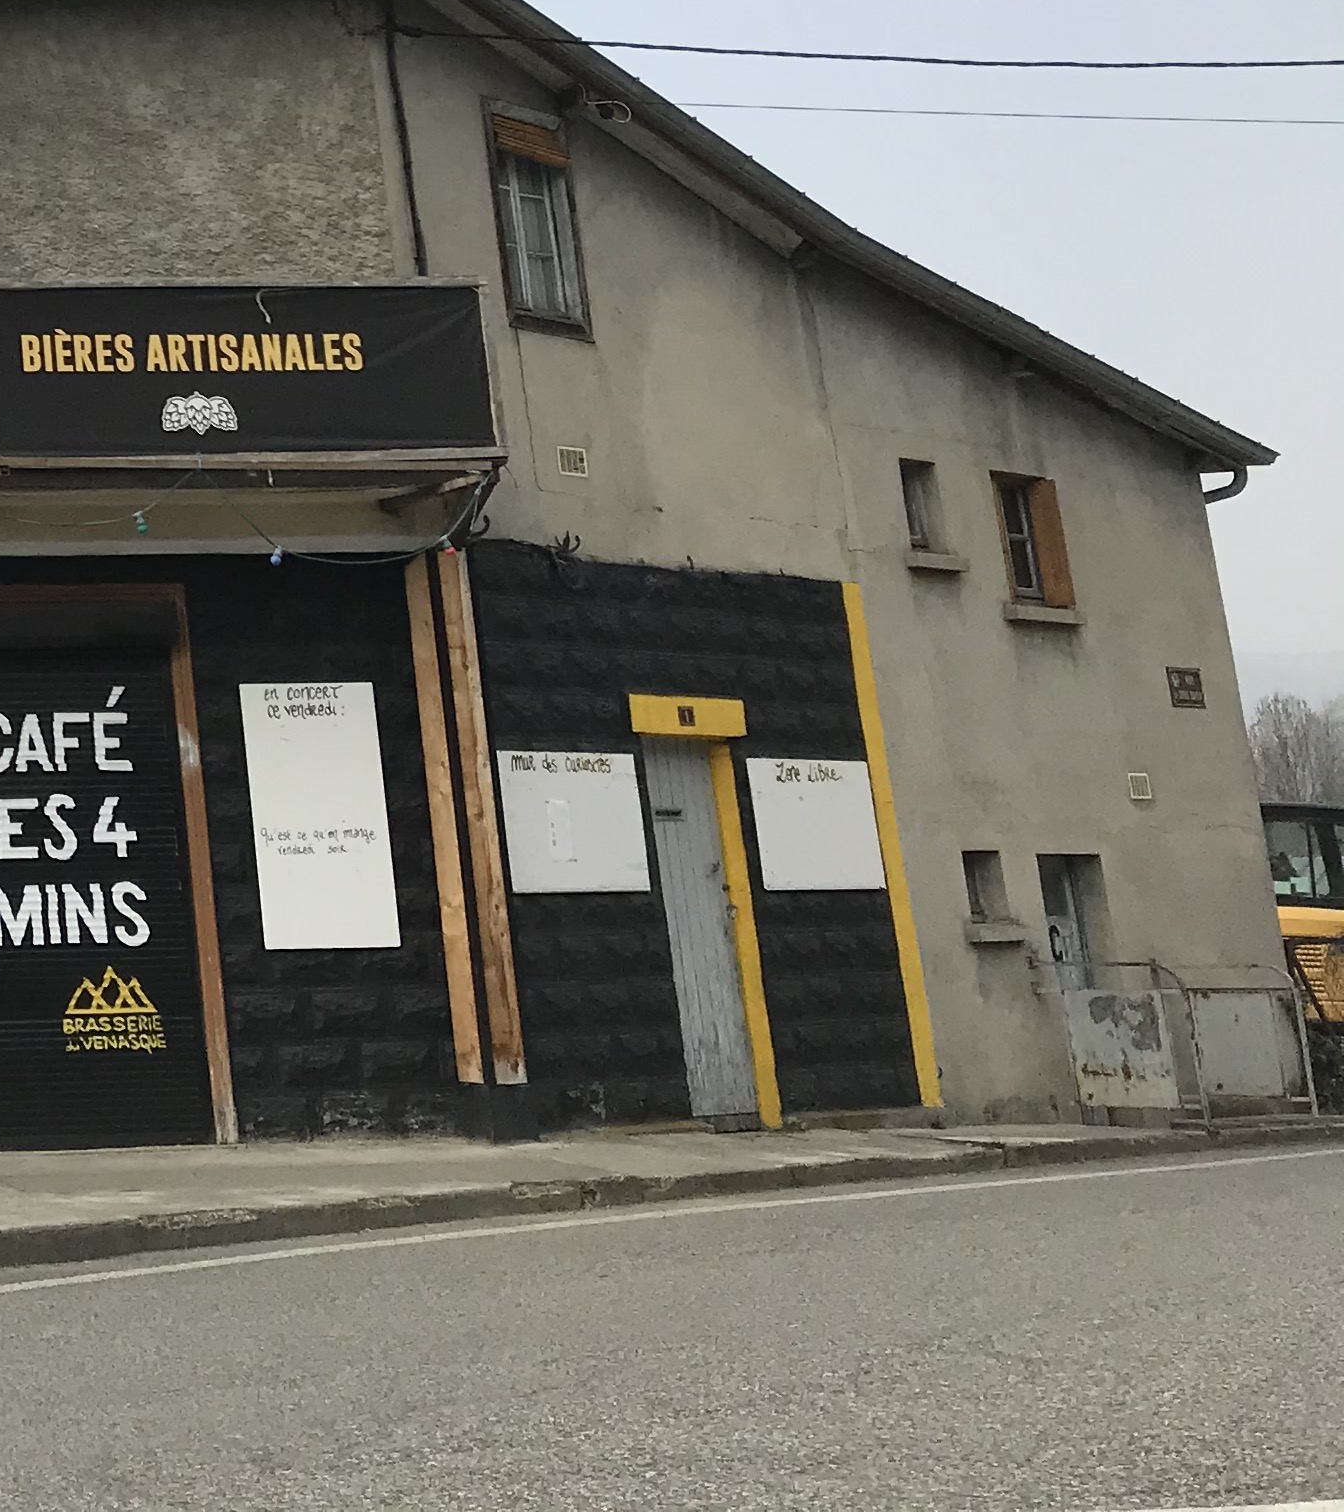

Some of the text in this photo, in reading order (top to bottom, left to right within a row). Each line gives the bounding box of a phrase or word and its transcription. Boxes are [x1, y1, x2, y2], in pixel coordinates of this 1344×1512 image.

[20, 328, 364, 372] BIÈRES ARTISANALES
[92, 796, 138, 858] 4
[62, 1014, 164, 1035] BRASSERIE
